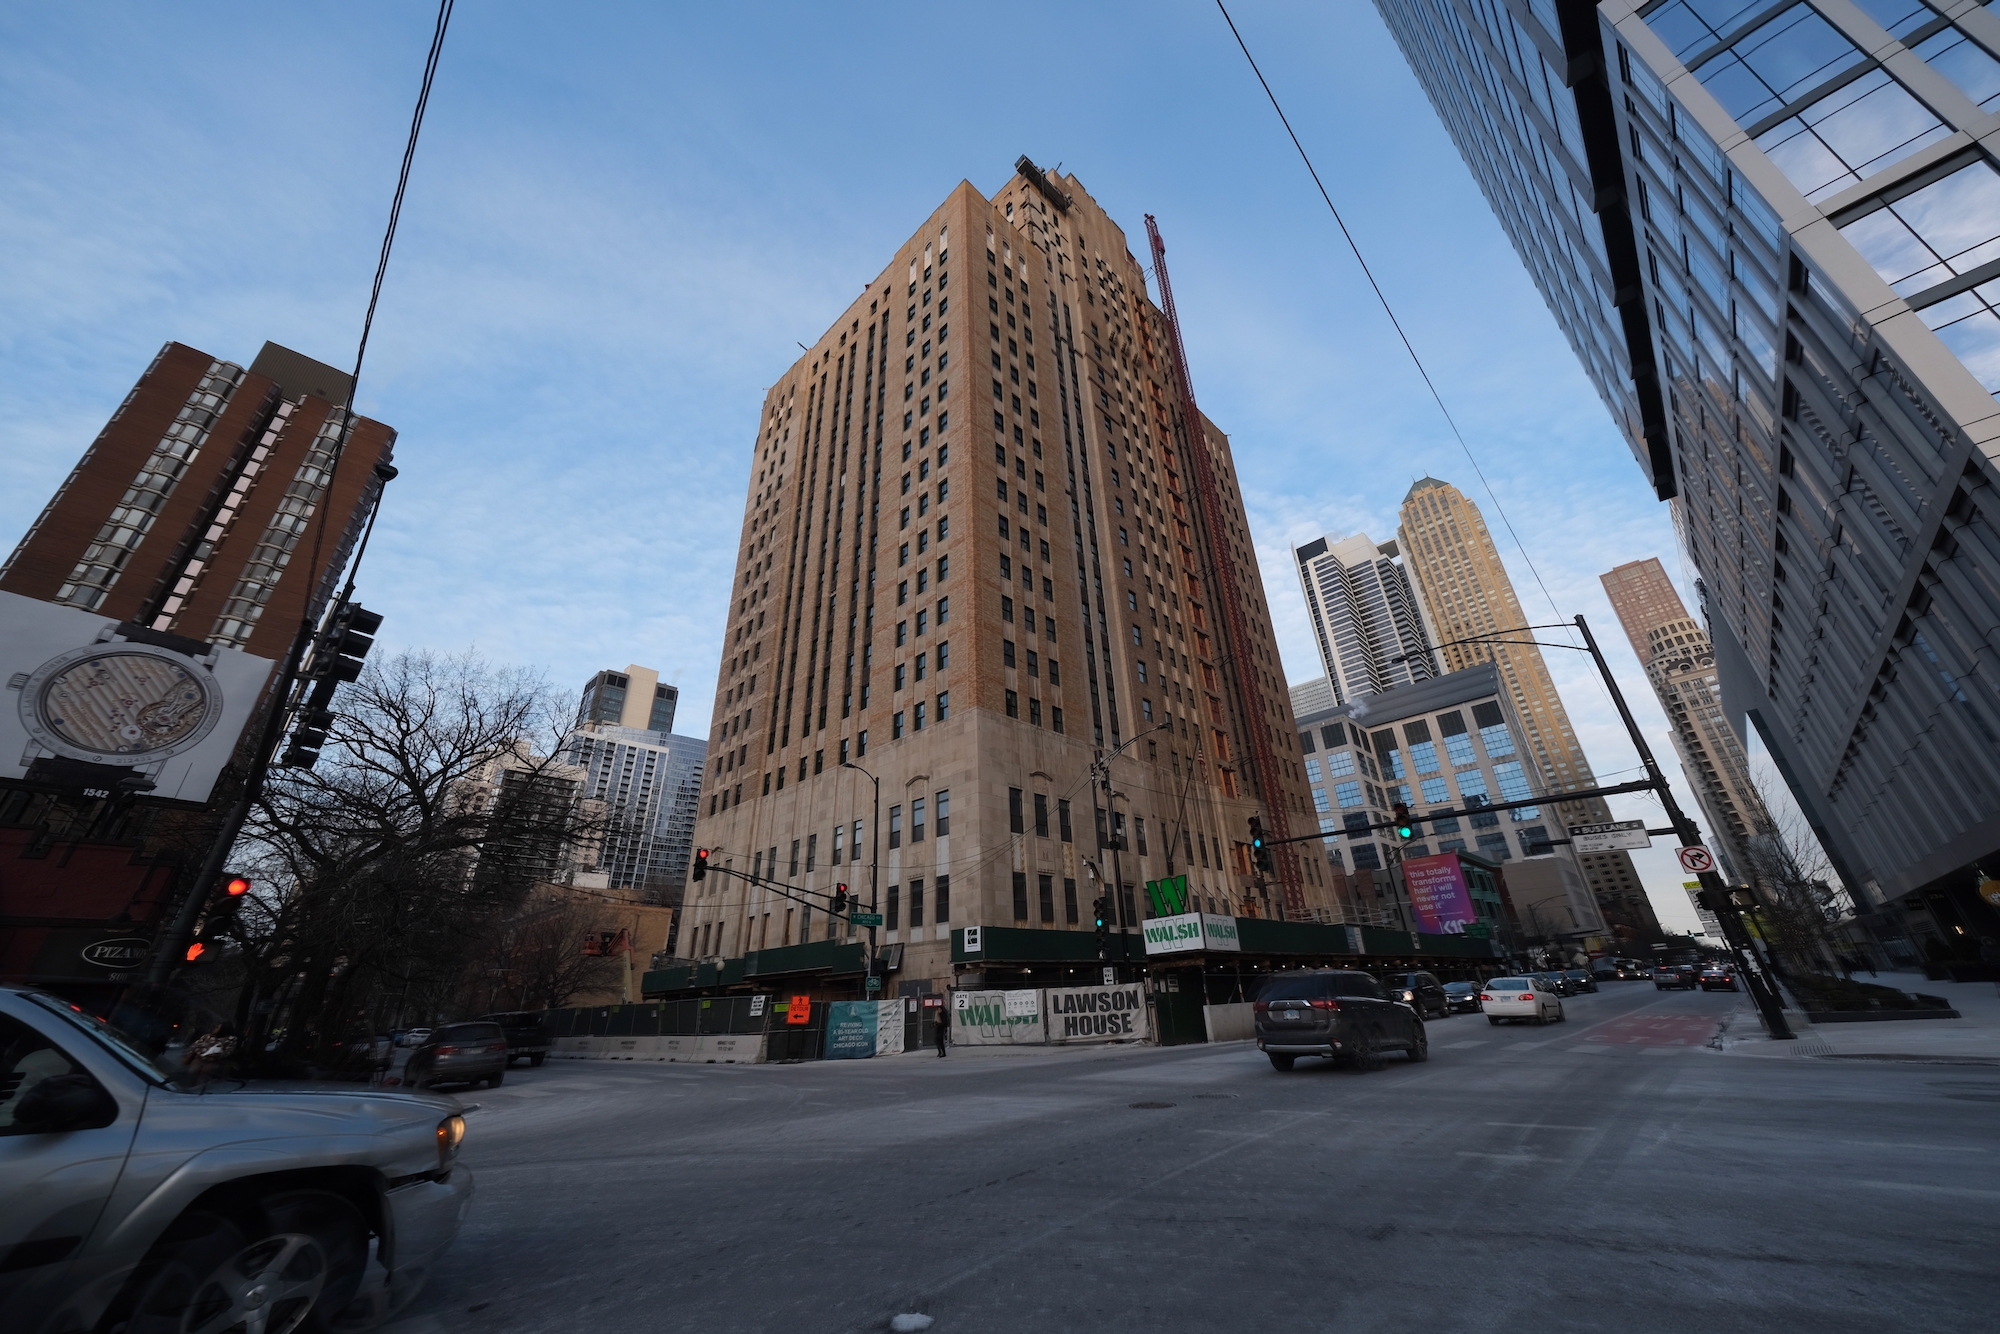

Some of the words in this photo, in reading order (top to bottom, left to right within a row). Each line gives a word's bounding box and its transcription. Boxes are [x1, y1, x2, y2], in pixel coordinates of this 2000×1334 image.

[82, 788, 110, 799] 1542
[1581, 825, 1602, 834] BUS
[1603, 822, 1629, 832] LANE
[1583, 834, 1608, 842] BUSES
[1426, 866, 1451, 876] totally
[1411, 875, 1457, 886] transforms
[1413, 886, 1432, 895] hair!
[1438, 883, 1453, 891] will
[1416, 894, 1439, 902] never
[1441, 891, 1456, 900] not
[1145, 922, 1200, 943] WALSH
[1206, 923, 1236, 939] WALSH
[959, 999, 965, 1008] 2
[1052, 990, 1140, 1014] LAWSON
[1064, 1013, 1133, 1036] HOUSE
[1583, 1035, 1689, 1045] CTA
